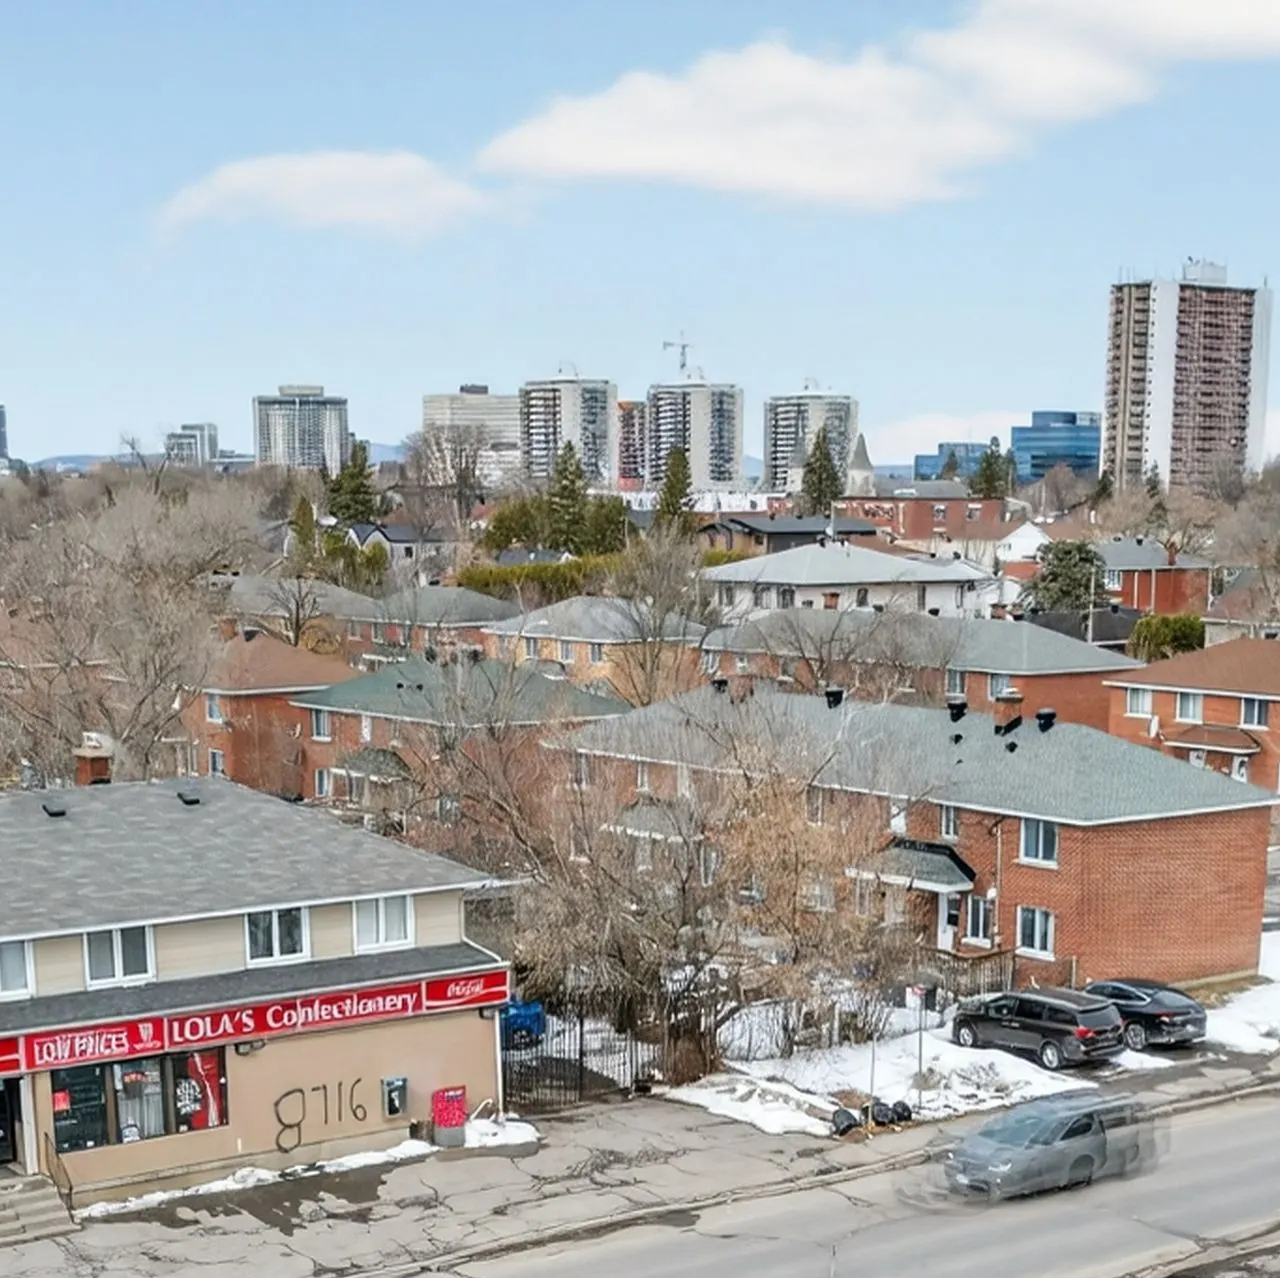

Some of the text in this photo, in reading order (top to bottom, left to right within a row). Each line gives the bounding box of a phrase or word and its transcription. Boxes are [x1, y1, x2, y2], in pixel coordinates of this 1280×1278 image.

[172, 992, 418, 1042] LOLA'S Confectionery
[273, 1077, 367, 1153] 8716
